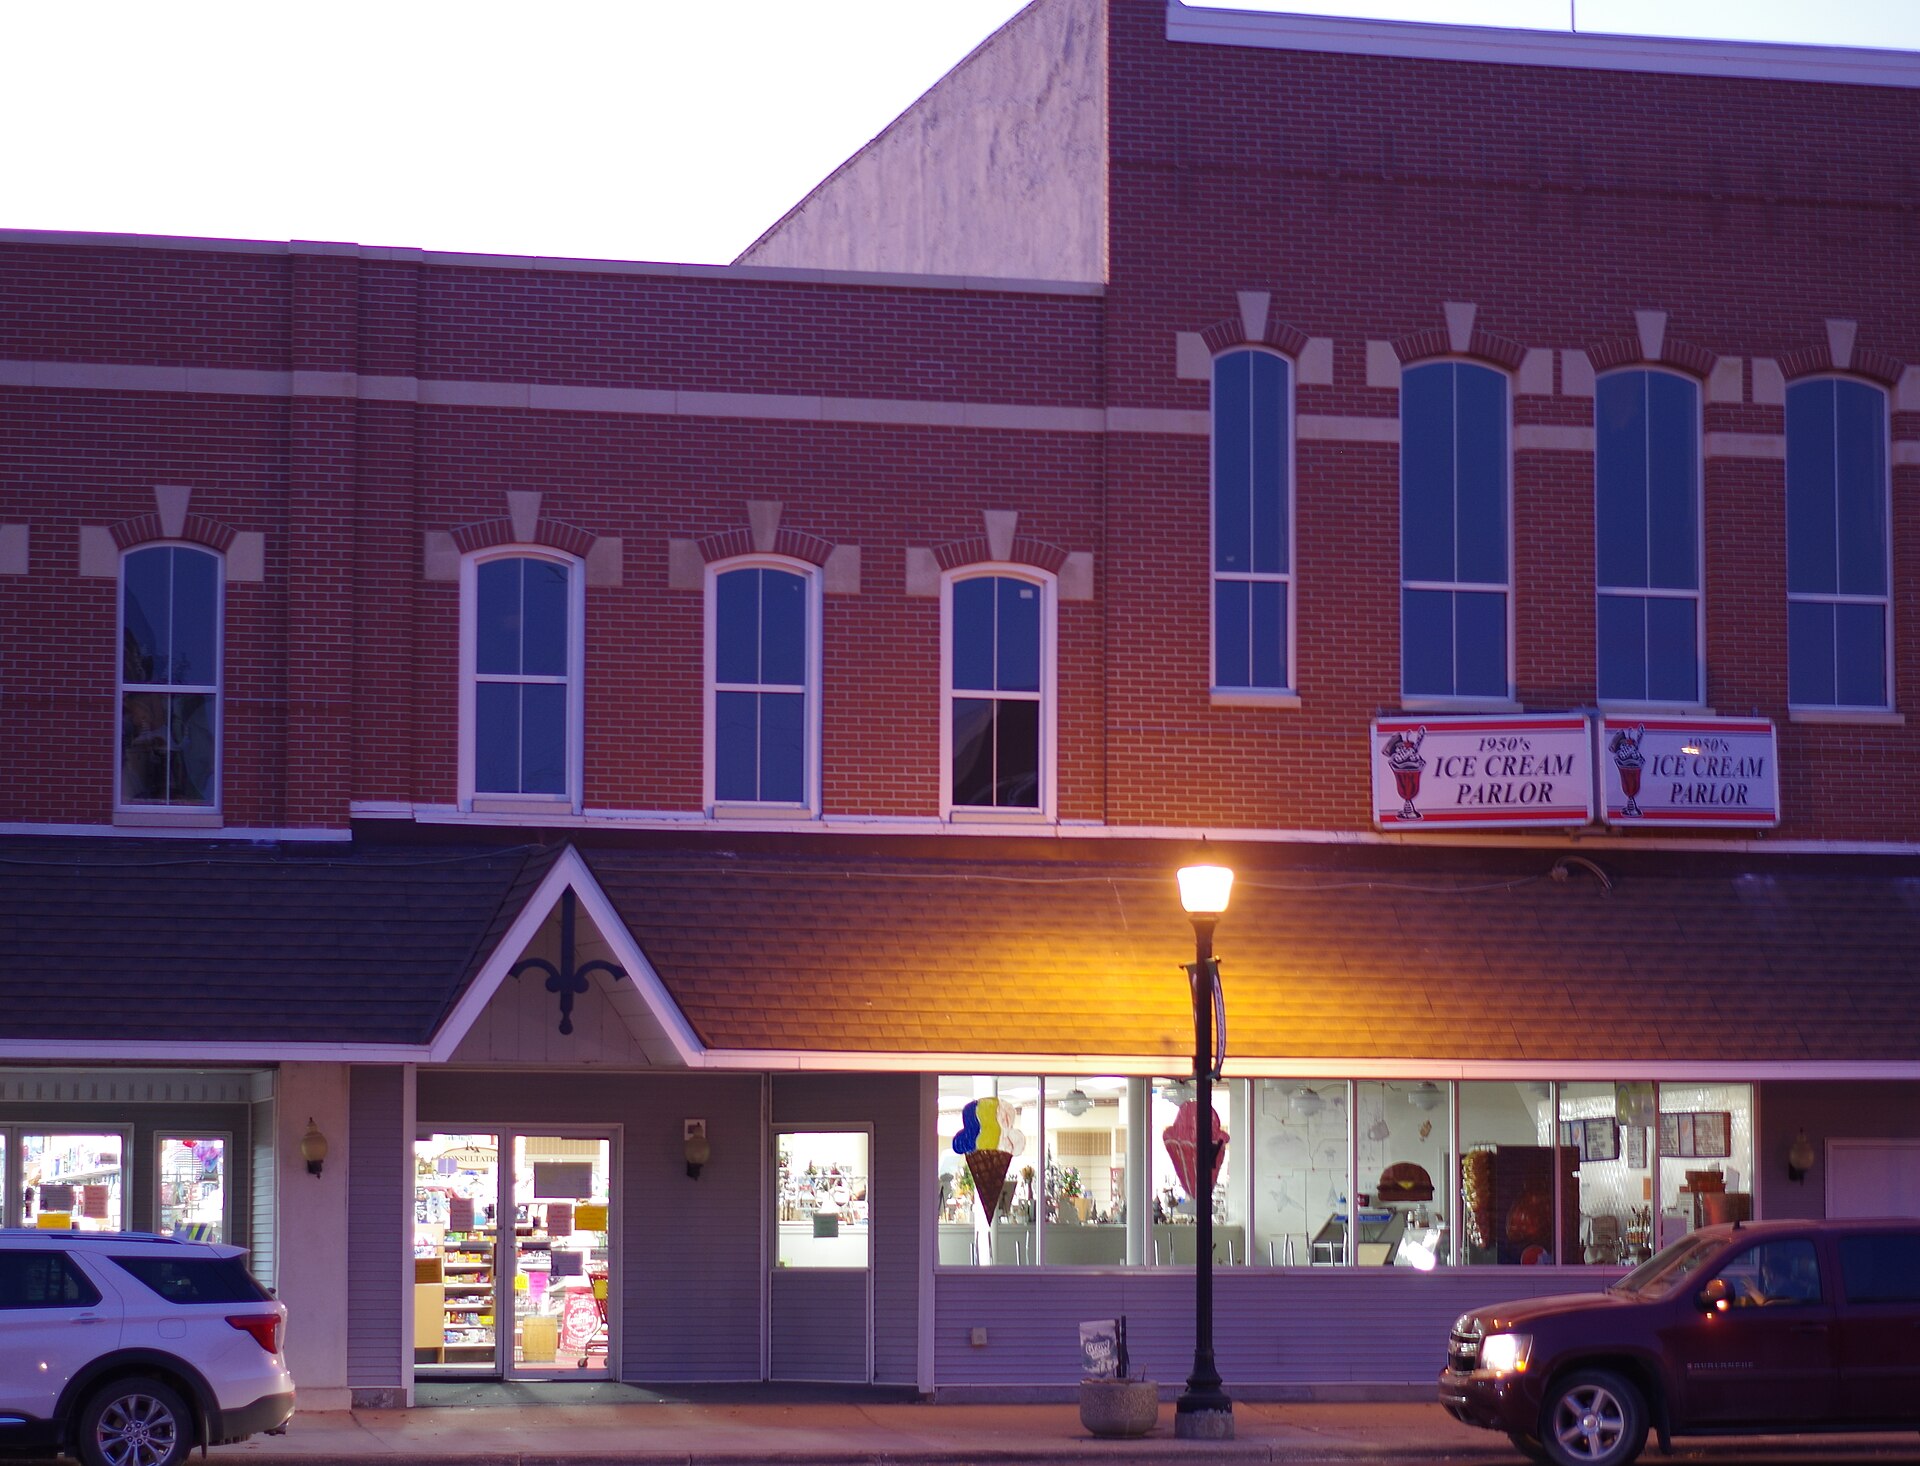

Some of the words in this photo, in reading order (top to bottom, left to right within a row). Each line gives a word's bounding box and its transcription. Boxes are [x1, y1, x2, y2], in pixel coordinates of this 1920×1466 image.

[1479, 737, 1531, 752] 1950's
[1434, 755, 1477, 778] ICE
[1484, 753, 1575, 778] CREAM
[1652, 754, 1686, 777] ICE
[1692, 755, 1764, 779] CREAM
[1456, 781, 1553, 805] PARLOR
[1670, 782, 1748, 805] PARLOR
